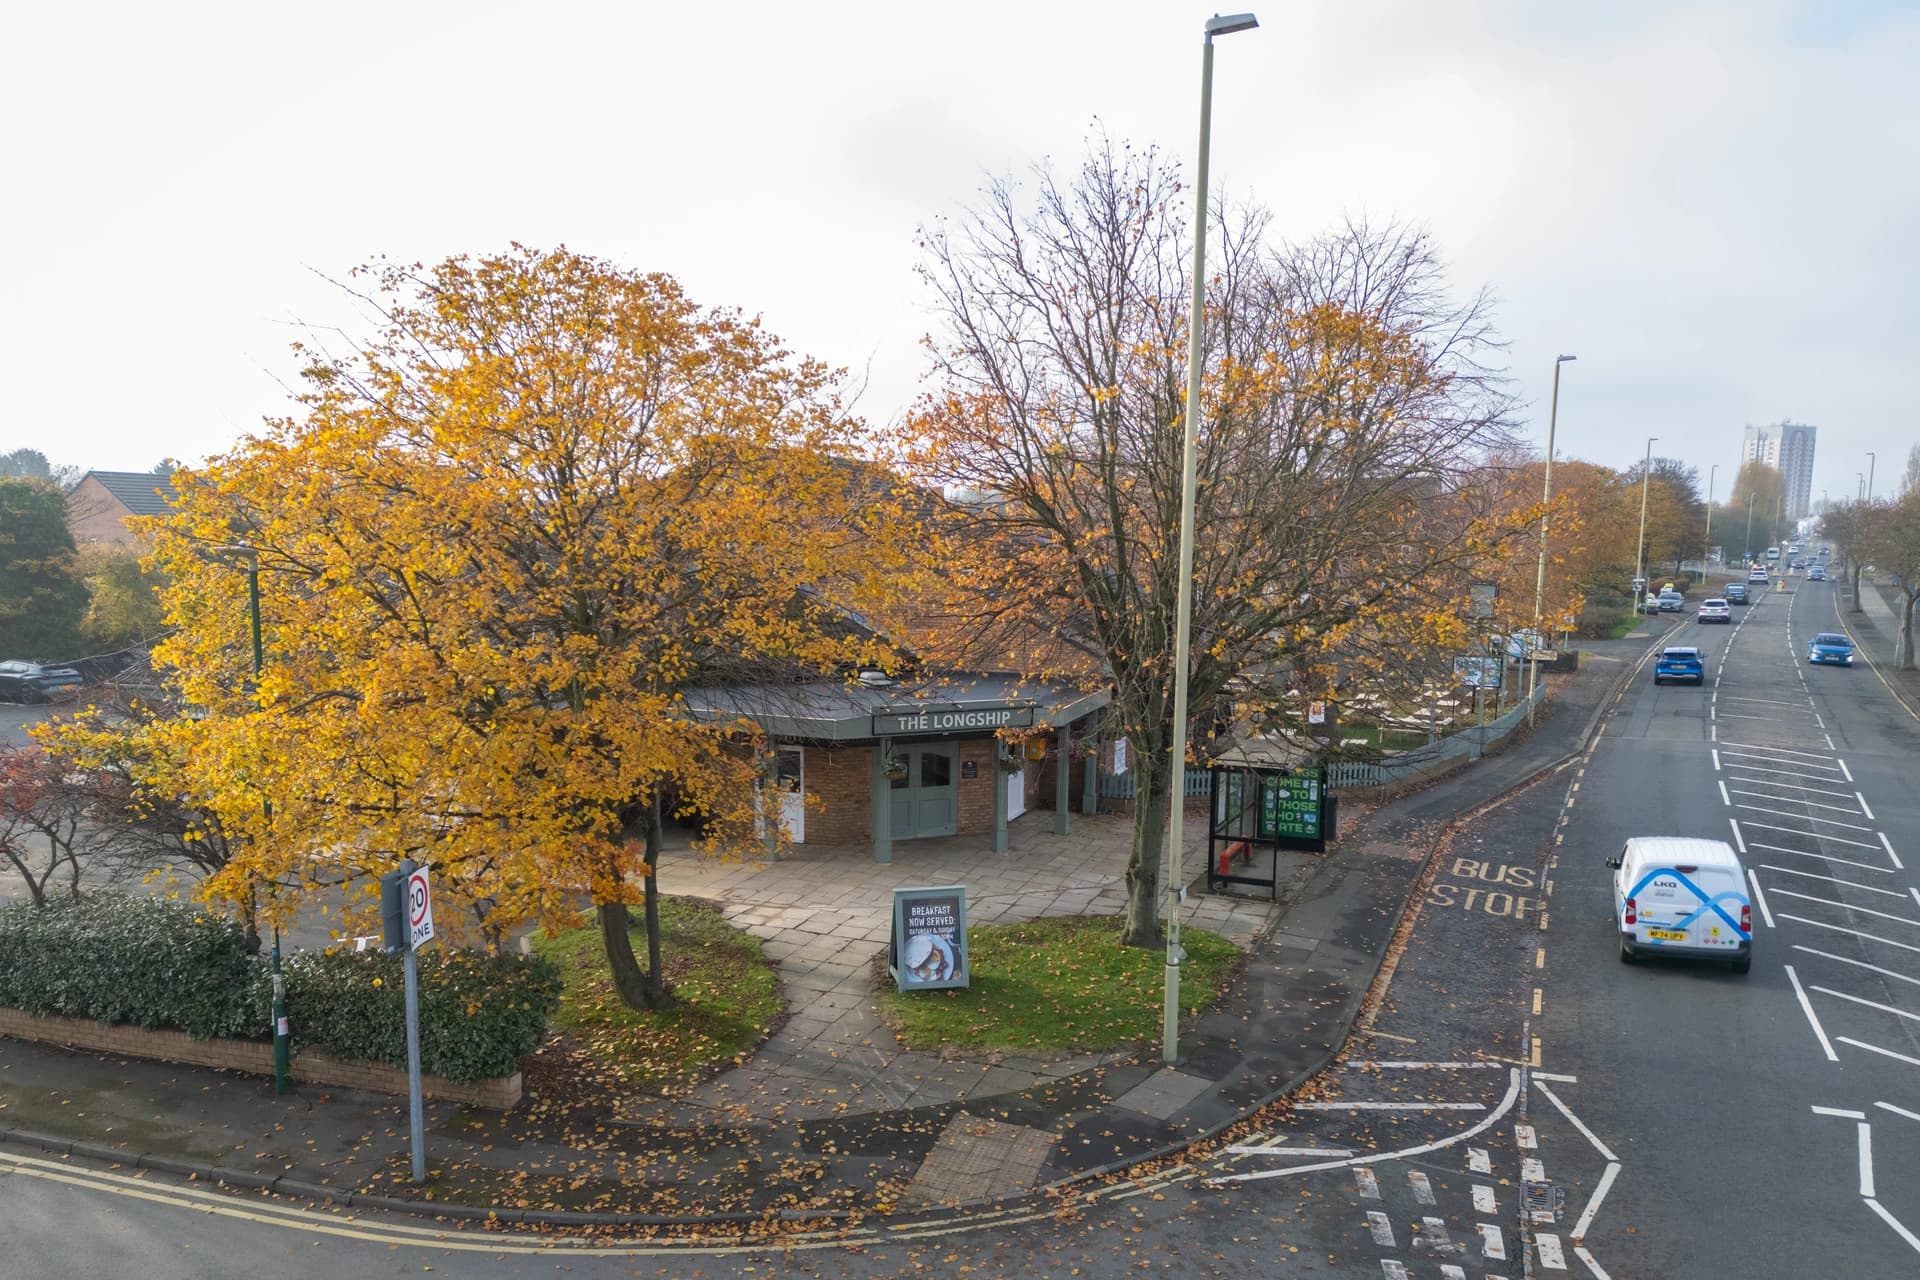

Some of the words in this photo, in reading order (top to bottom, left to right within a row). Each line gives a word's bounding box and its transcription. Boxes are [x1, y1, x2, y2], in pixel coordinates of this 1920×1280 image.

[897, 715, 929, 731] THE
[933, 711, 1012, 730] LONGSHIP
[1266, 776, 1302, 788] COME
[1291, 789, 1309, 800] TO
[1265, 809, 1295, 821] WHO
[1278, 822, 1304, 832] ATE
[1450, 857, 1537, 888] BUS
[1653, 880, 1677, 889] LKQ
[410, 887, 424, 913] 20
[1426, 884, 1547, 920] STOP
[911, 905, 951, 916] BREAKFAST
[908, 917, 925, 927] NOW
[411, 922, 431, 945] ONE
